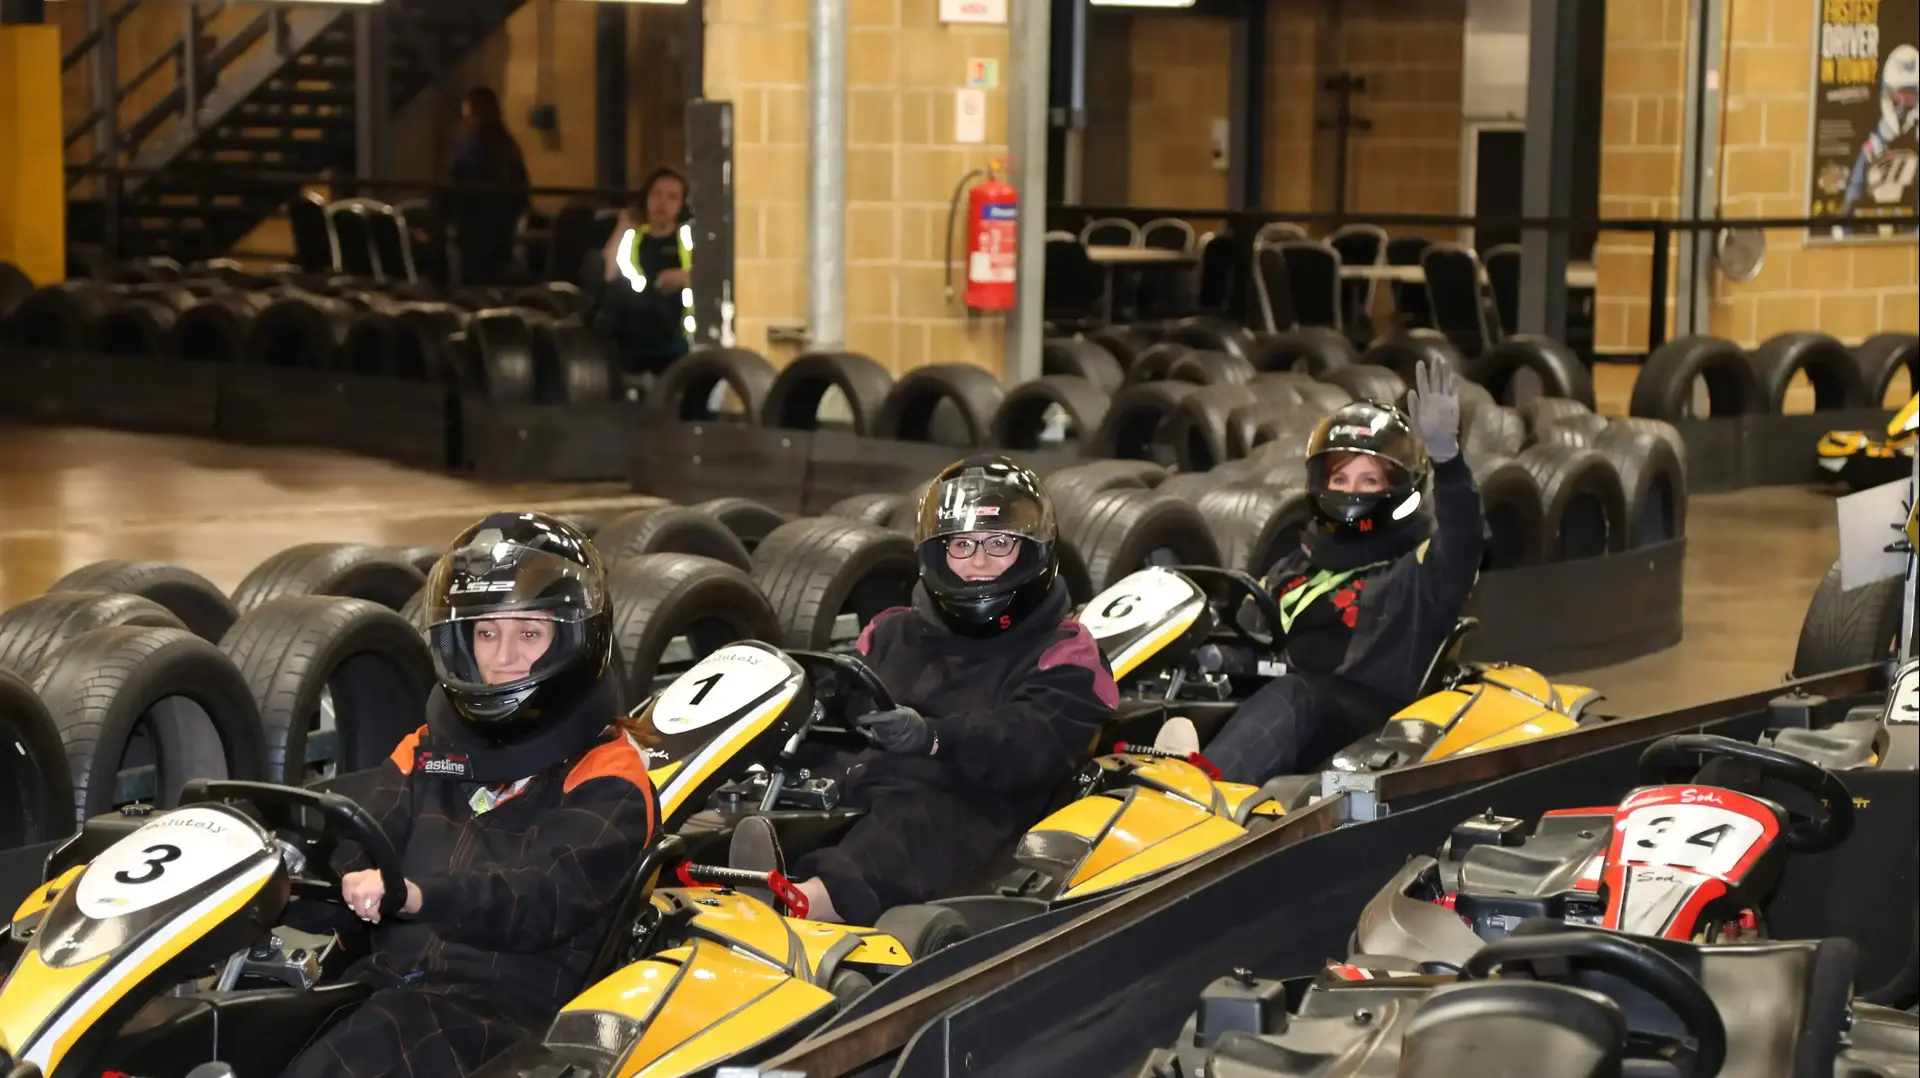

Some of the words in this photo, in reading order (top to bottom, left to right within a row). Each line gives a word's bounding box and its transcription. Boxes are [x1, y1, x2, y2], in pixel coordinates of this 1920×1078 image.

[1822, 23, 1879, 58] DRIVER
[1820, 58, 1835, 83] IN
[1360, 518, 1373, 532] M
[449, 580, 516, 594] LS2
[1101, 594, 1141, 618] 6
[1000, 614, 1011, 630] S
[688, 673, 725, 706] 1
[114, 844, 182, 885] 3
